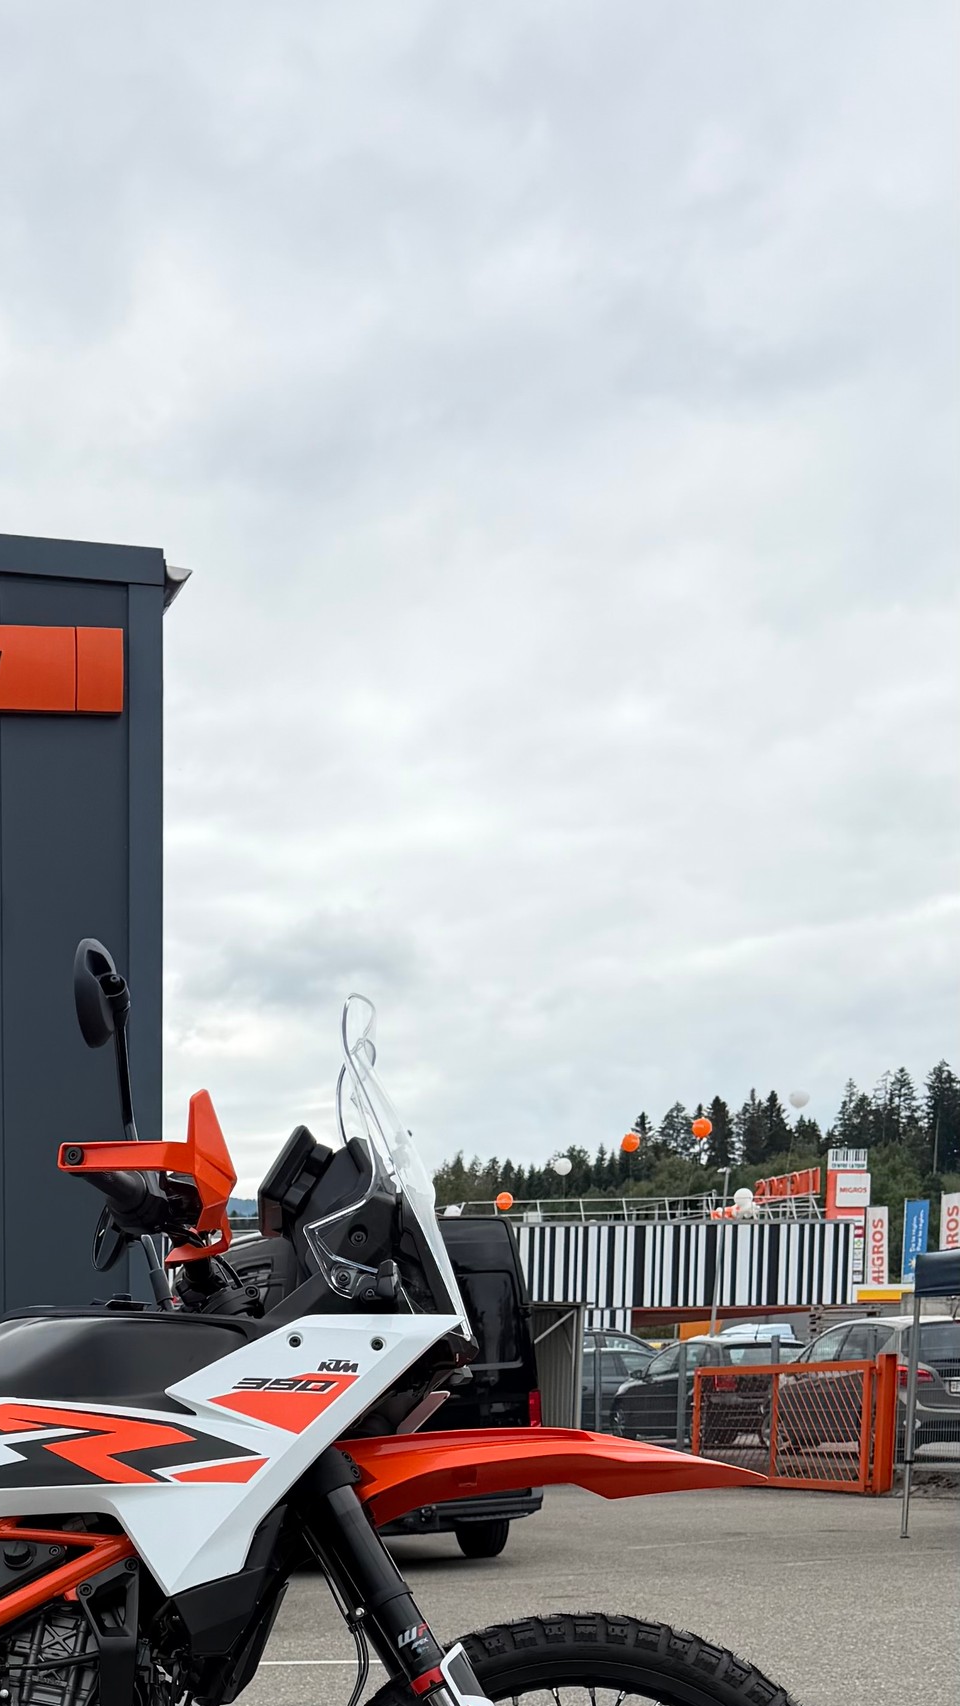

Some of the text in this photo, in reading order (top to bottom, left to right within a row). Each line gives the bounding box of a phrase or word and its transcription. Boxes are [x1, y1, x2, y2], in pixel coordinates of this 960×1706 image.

[945, 1205, 960, 1248] ROS
[317, 1359, 359, 1373] KTM
[231, 1378, 340, 1392] 390
